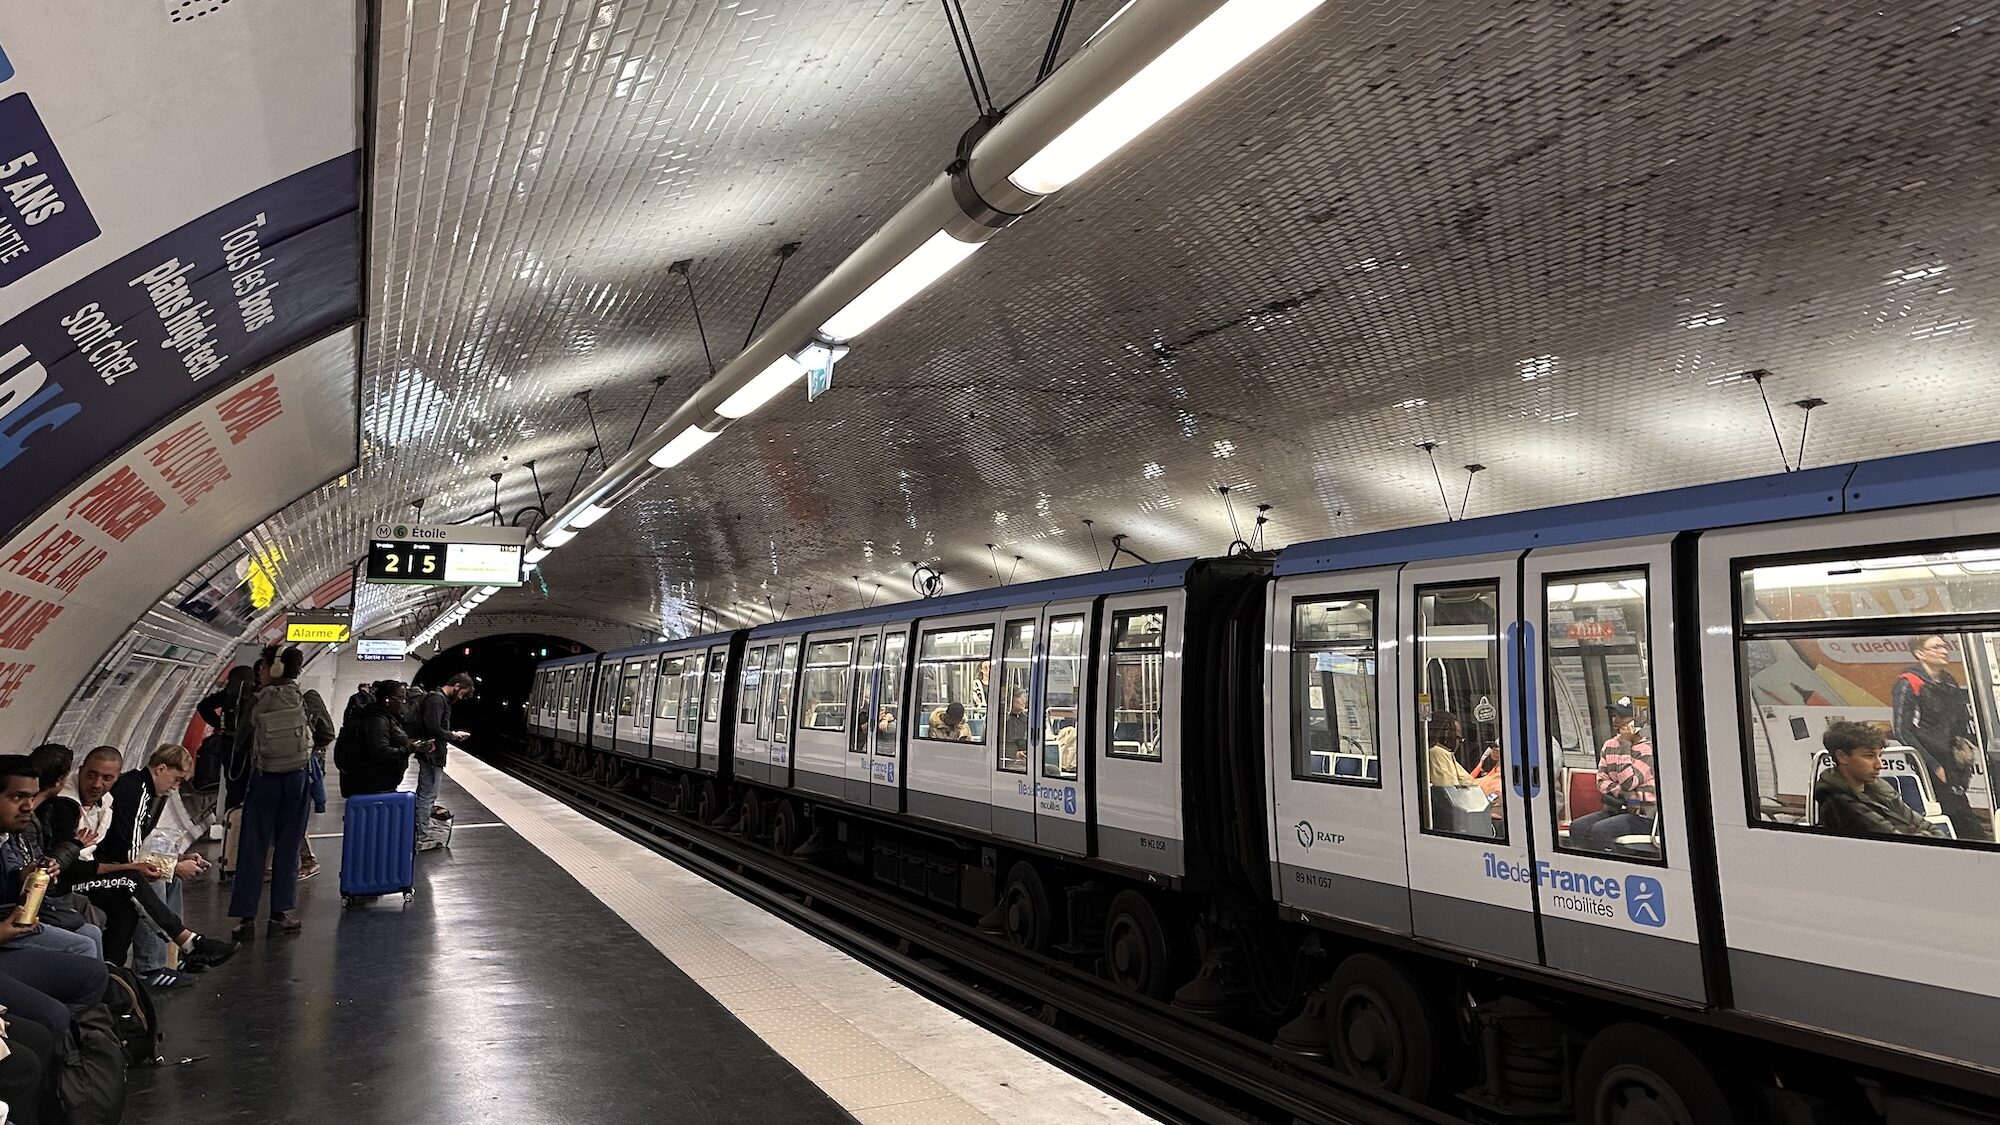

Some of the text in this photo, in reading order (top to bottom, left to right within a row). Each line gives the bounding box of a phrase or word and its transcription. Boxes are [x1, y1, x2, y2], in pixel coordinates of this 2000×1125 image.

[3, 172, 66, 226] ANS
[220, 212, 280, 333] Tous les bons
[128, 257, 229, 382] plans high-tech
[60, 302, 139, 386] sont chez
[215, 373, 283, 446] ROYAL
[143, 420, 232, 514] AU LOUVRE,
[68, 464, 166, 543] PRINCIER
[412, 525, 447, 539] Étoile
[16, 529, 86, 584] BEL
[384, 553, 400, 573] 2
[421, 555, 437, 574] 5
[292, 628, 334, 639] Alarme
[1317, 831, 1345, 844] RATP
[1296, 871, 1332, 889] 89 N1 057
[1537, 860, 1620, 899] France
[1553, 894, 1614, 918] mobilités
